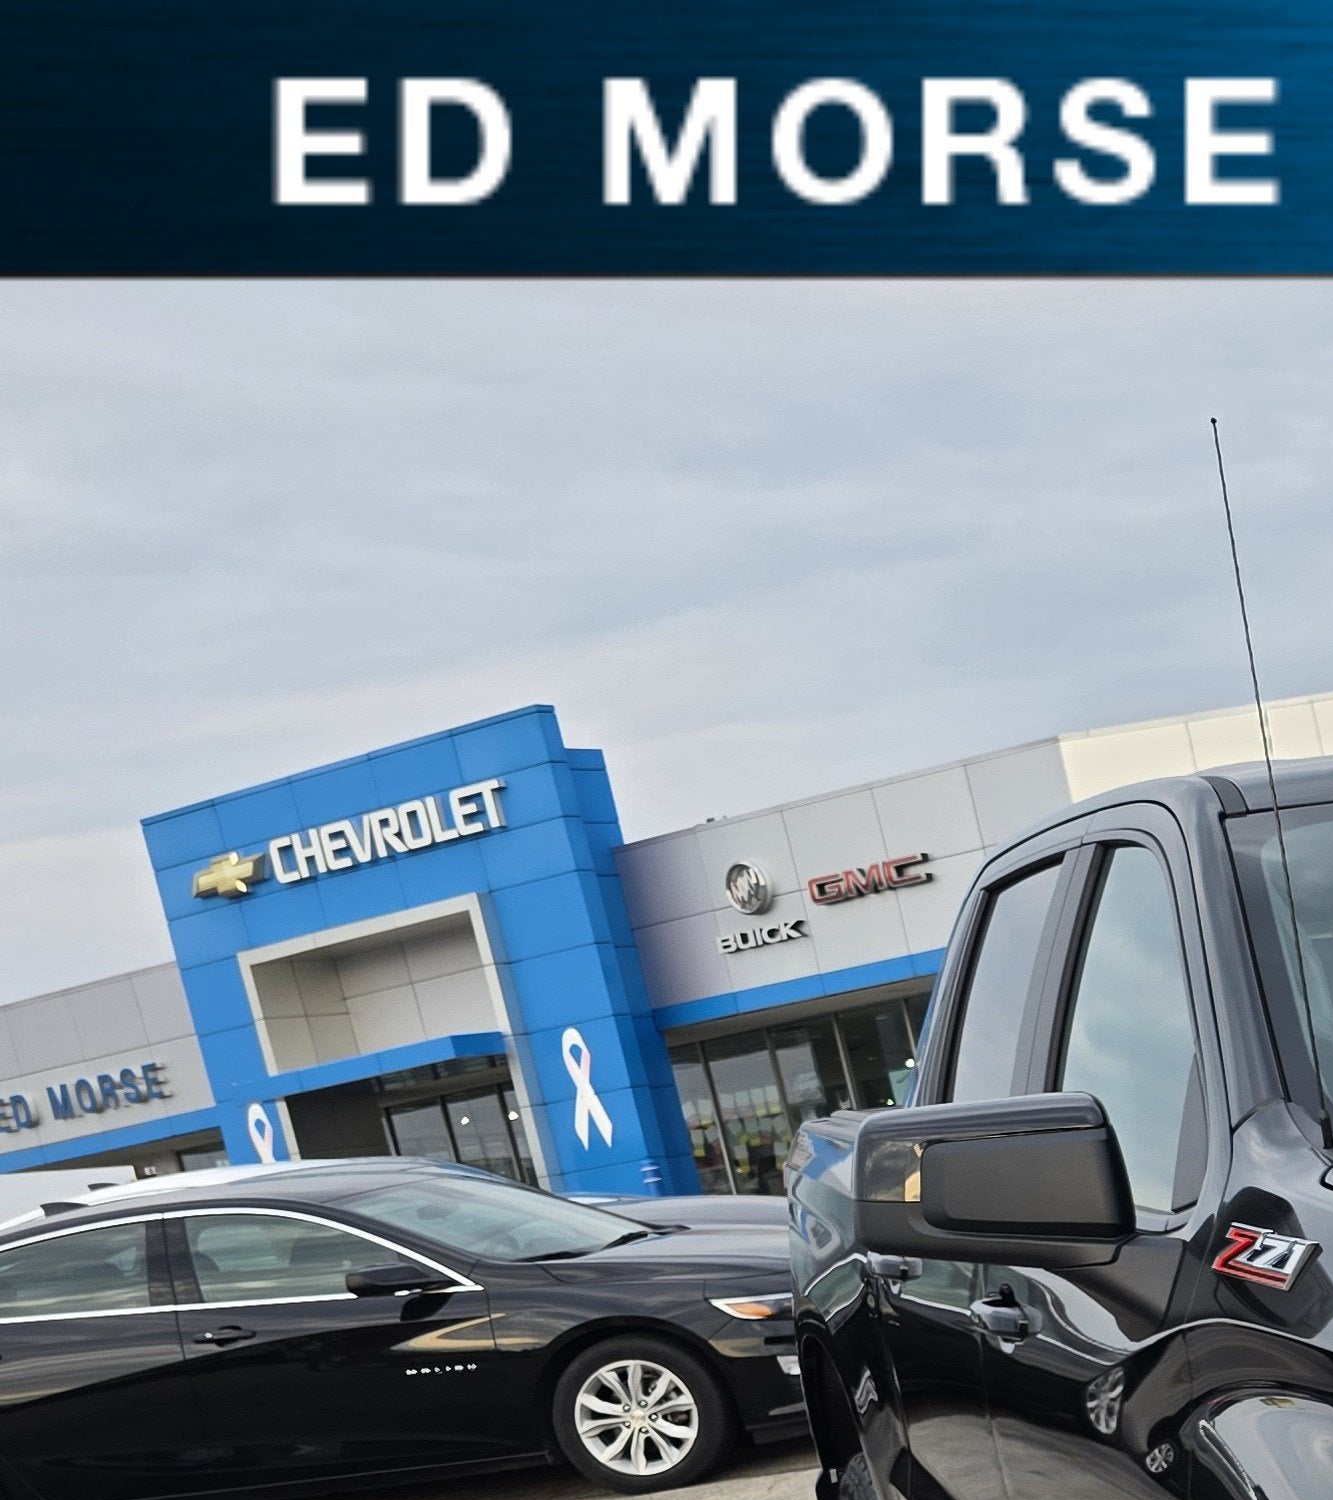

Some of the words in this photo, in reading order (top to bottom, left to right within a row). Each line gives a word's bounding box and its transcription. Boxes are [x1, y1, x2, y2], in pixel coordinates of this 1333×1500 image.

[269, 778, 506, 884] CHEVROLET
[808, 853, 933, 905] GMC
[717, 920, 808, 955] BUICK
[0, 1094, 40, 1133] ED
[46, 1062, 173, 1121] MORSE
[1211, 1221, 1323, 1292] Z71
